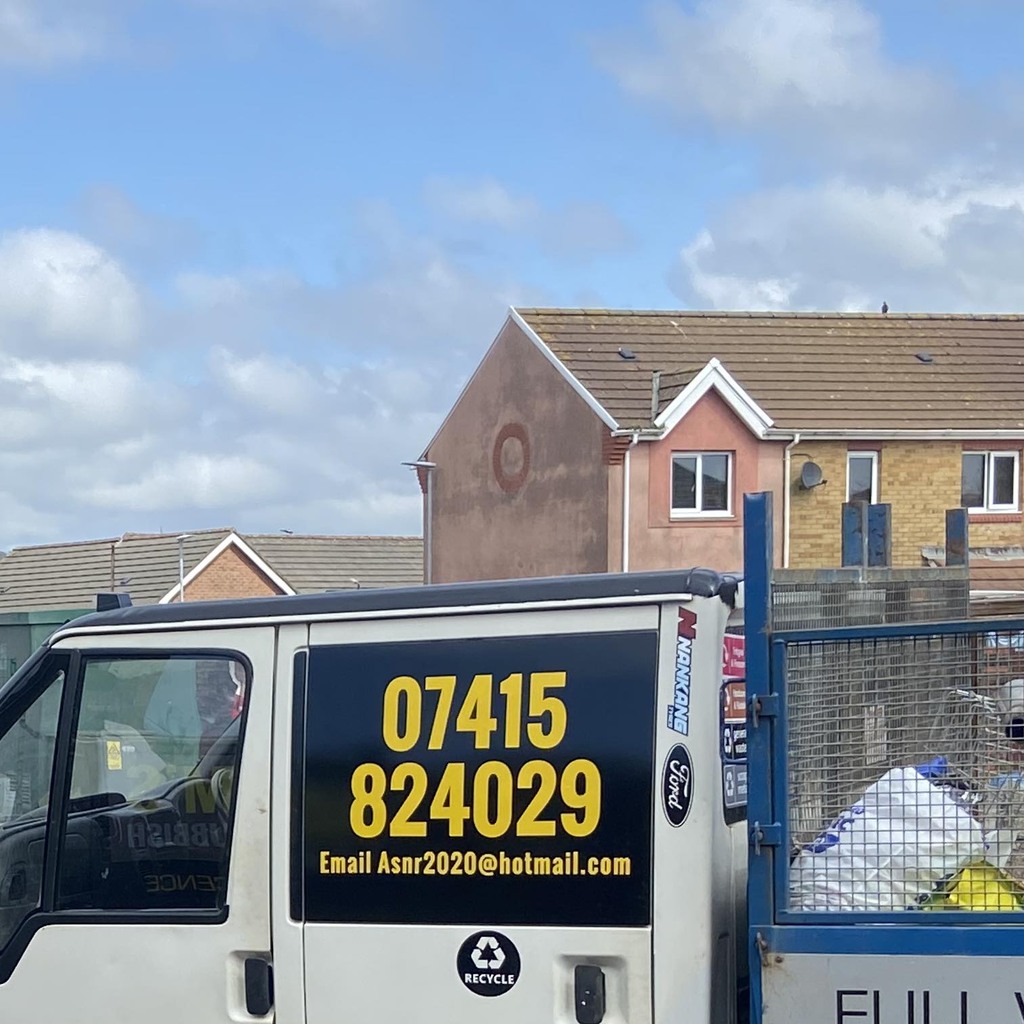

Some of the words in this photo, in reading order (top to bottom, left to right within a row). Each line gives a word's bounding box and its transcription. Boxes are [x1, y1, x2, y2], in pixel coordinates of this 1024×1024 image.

[382, 671, 567, 752] 07415
[674, 636, 693, 736] NANKANG
[349, 758, 602, 839] 824029
[668, 760, 689, 811] Ford
[319, 850, 371, 875] Email
[377, 850, 632, 877] Asnr2020@hotmail.com
[464, 973, 515, 985] RECYCLE
